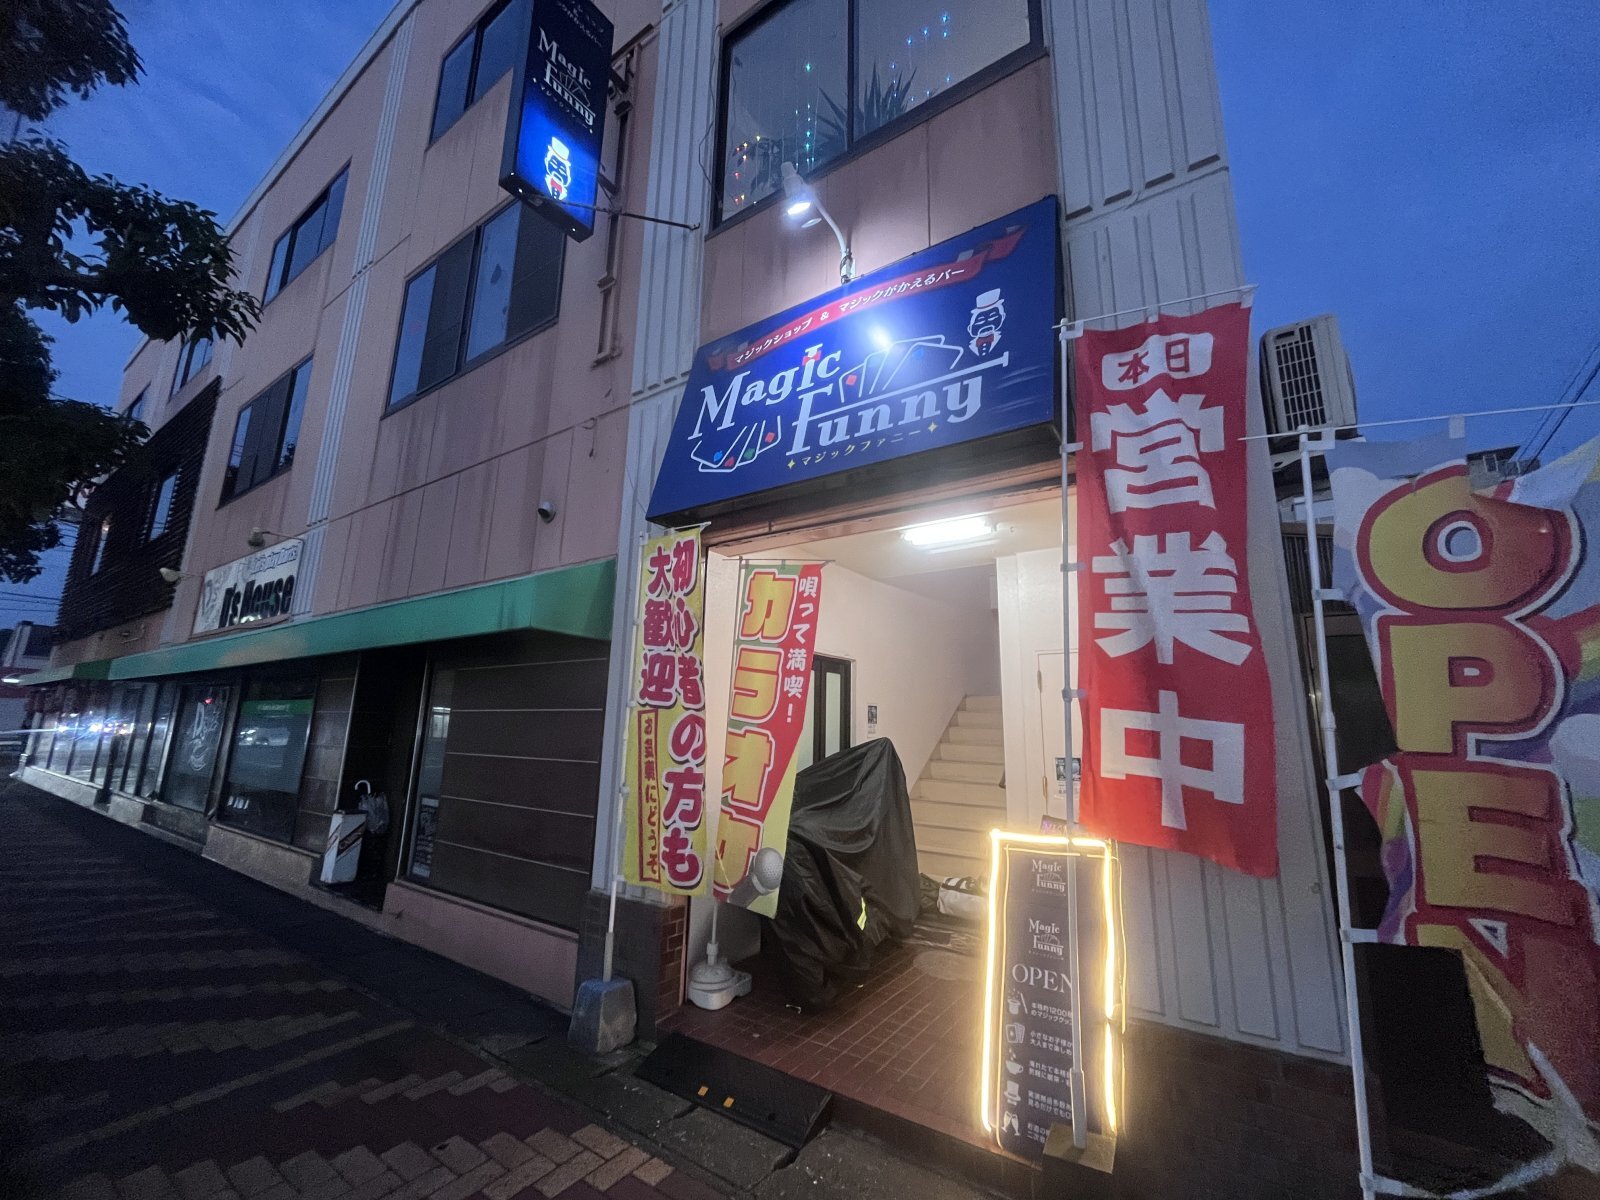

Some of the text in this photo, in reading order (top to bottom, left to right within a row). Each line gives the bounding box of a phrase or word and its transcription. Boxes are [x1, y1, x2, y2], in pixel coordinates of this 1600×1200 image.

[538, 26, 592, 90] Magic
[543, 60, 596, 126] Funny
[735, 267, 965, 363] マジックショップ & マジックがかえるバー
[688, 342, 841, 441] Magic
[1117, 337, 1190, 385] 本日
[786, 352, 1009, 458] Funny
[801, 430, 921, 466] マジックファニー
[639, 545, 676, 703] 大歓迎
[1090, 387, 1253, 832] 営業中
[661, 539, 706, 886] 初心者の方も
[712, 570, 798, 889] カラオケ
[1031, 859, 1062, 873] Magic
[1036, 873, 1066, 893] Funny
[1028, 918, 1060, 934] Magic
[1033, 934, 1064, 956] Funny
